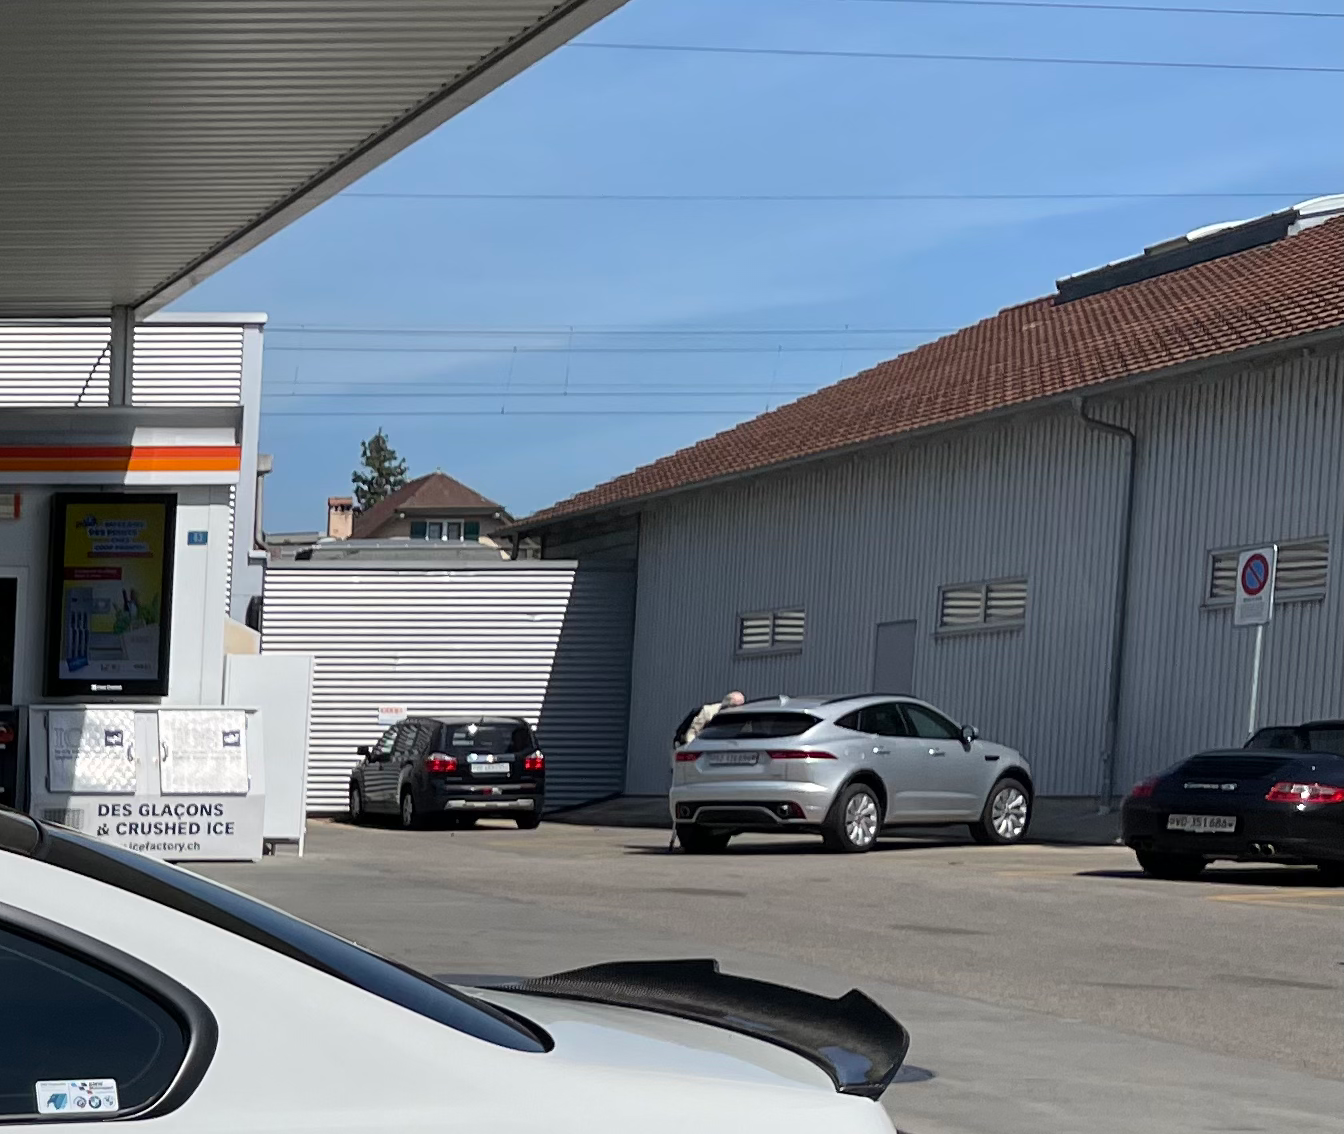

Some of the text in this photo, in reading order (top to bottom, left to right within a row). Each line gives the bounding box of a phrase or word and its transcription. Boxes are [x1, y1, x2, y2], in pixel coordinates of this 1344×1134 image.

[97, 803, 224, 820] DES GLAÇONS
[97, 822, 235, 836] & CRUSHED ICE
[128, 841, 201, 852] icefactory.ch
